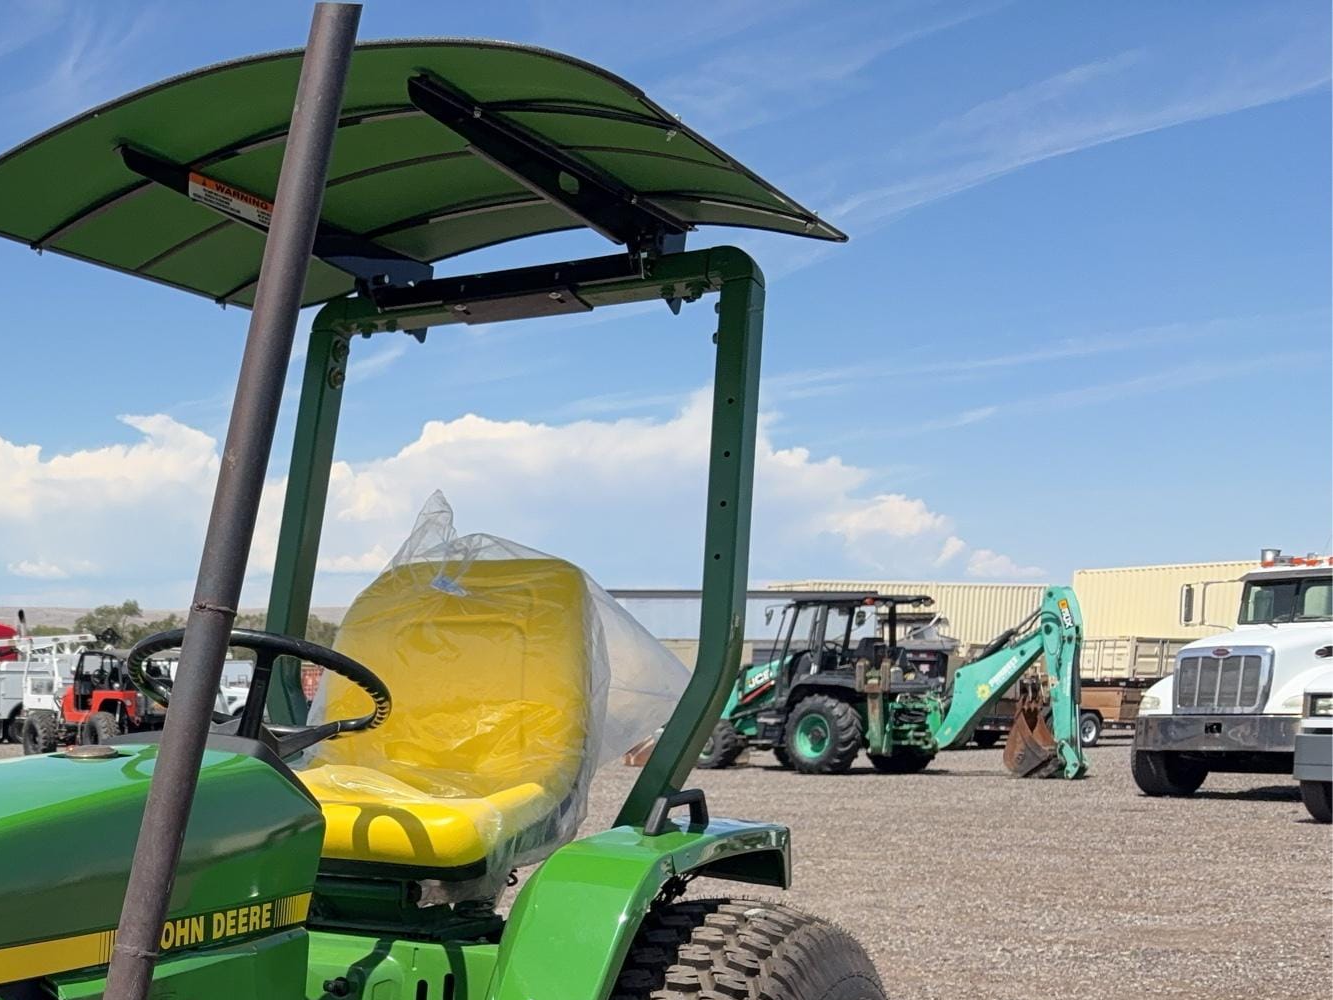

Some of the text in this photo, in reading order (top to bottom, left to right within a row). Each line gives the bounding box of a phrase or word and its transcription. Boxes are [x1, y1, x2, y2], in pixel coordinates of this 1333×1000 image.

[214, 183, 270, 210] WARNING
[160, 902, 273, 950] OHN DEERE
